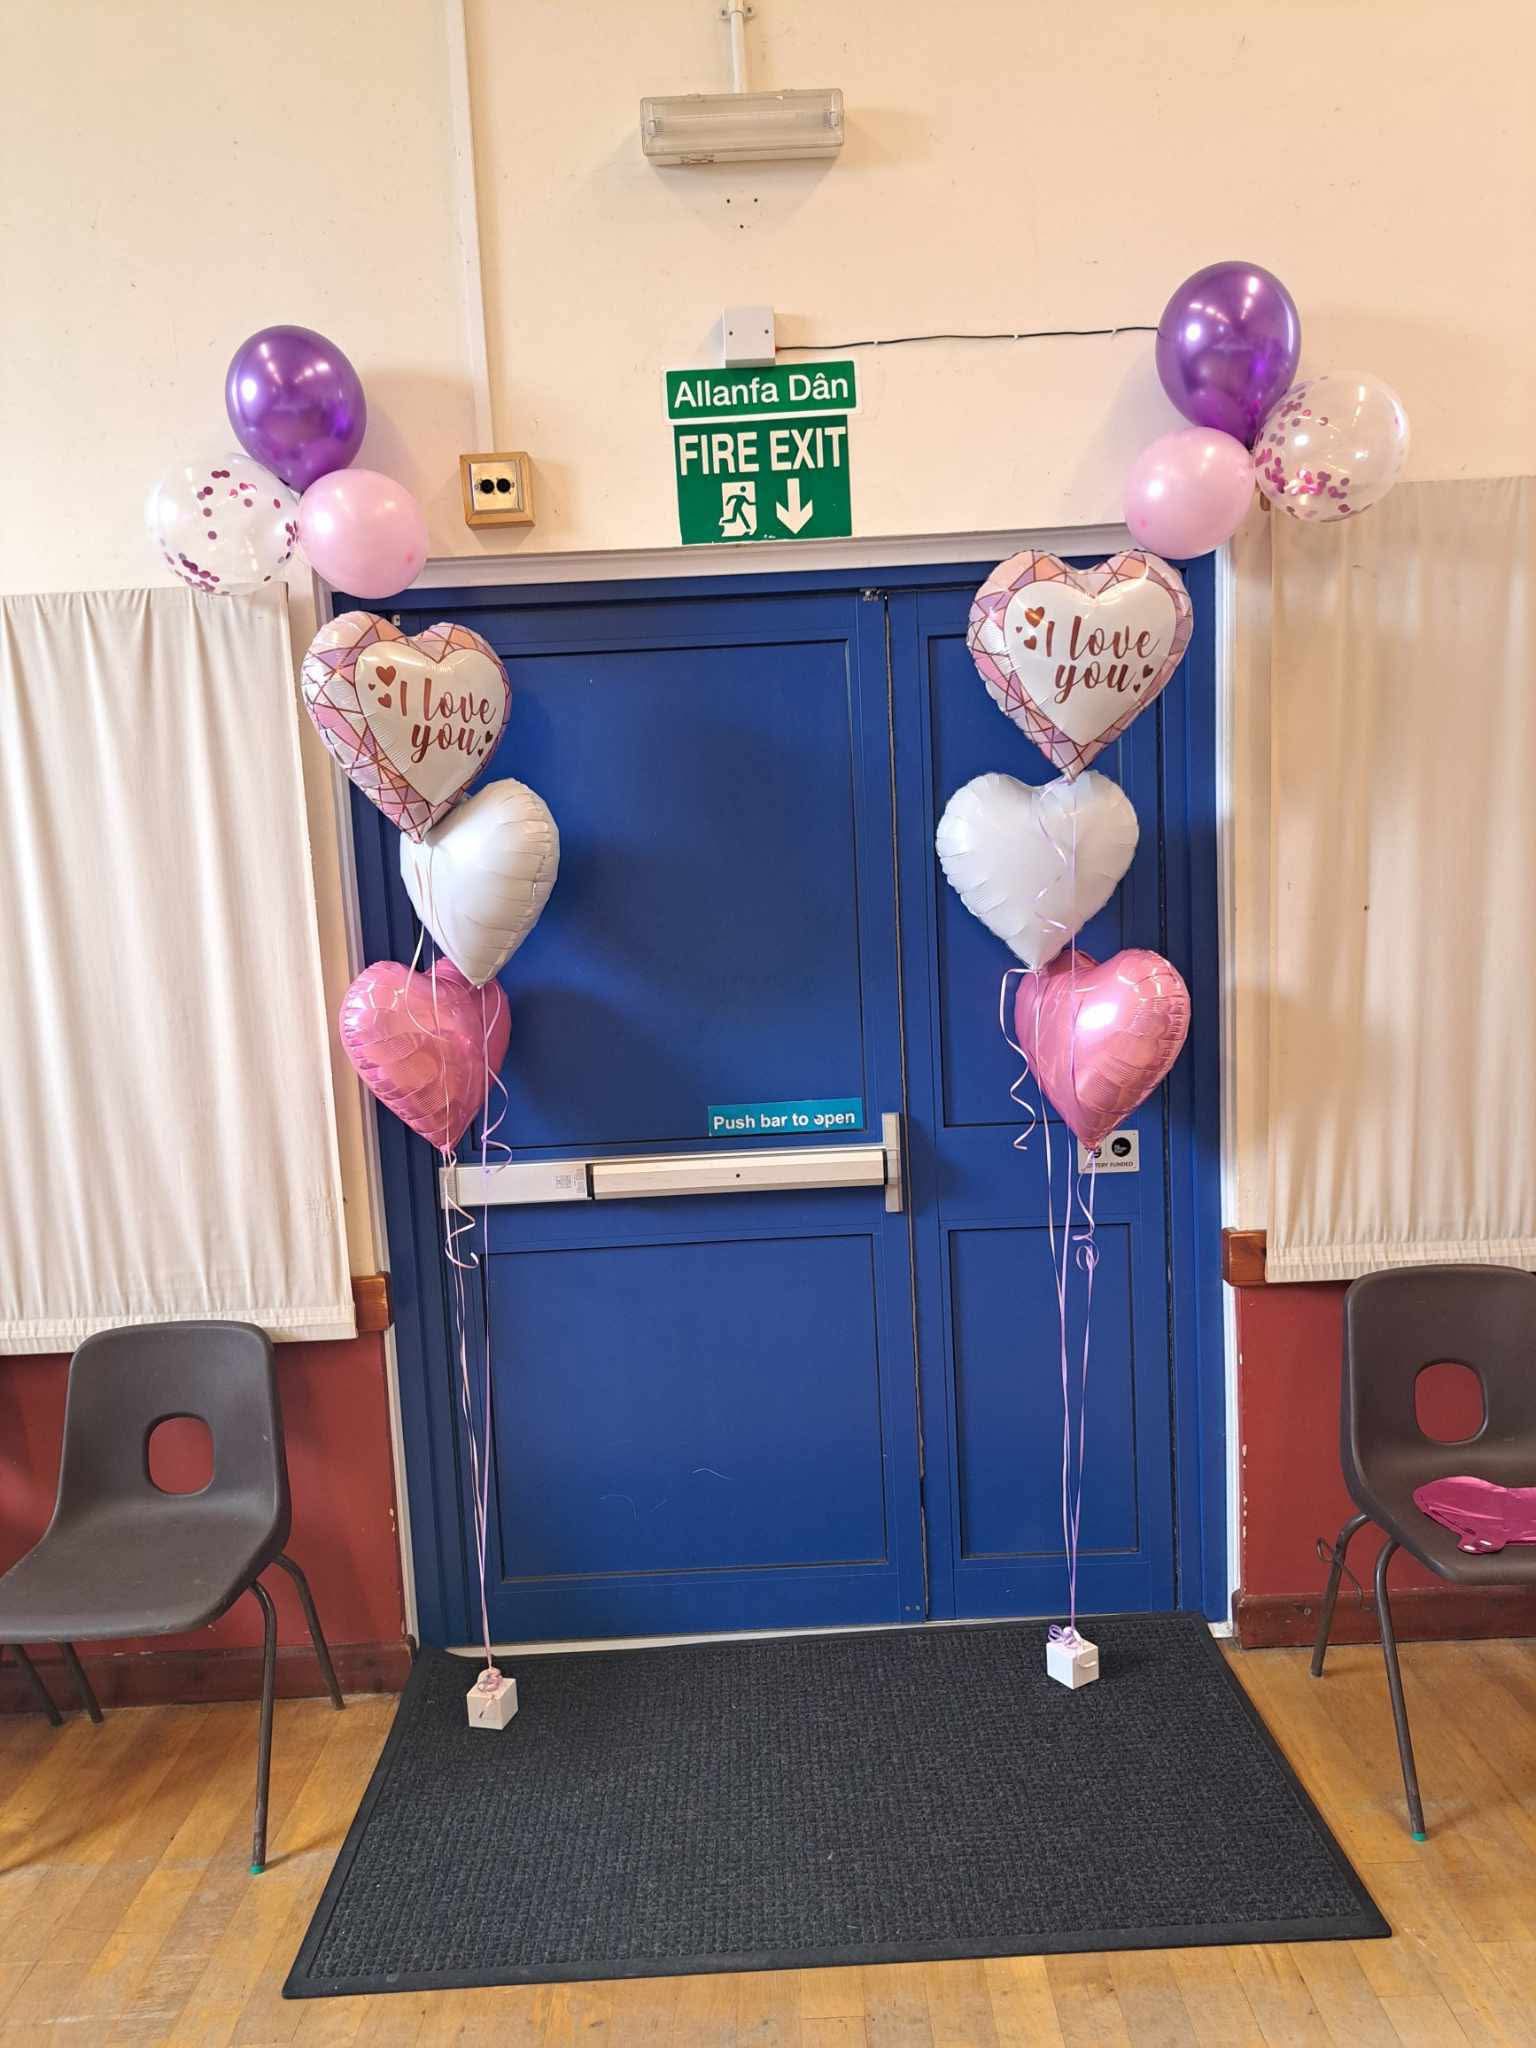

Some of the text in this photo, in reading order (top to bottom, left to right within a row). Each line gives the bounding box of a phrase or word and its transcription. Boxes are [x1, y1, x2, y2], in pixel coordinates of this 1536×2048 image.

[674, 373, 849, 409] Allanfa Dân
[678, 426, 847, 476] FIRE EXIT
[1046, 615, 1161, 661] I love
[400, 677, 497, 725] I love
[1054, 660, 1137, 704] you
[410, 722, 482, 764] you
[713, 1115, 756, 1130] Push
[760, 1113, 787, 1129] bar
[791, 1113, 809, 1127] to
